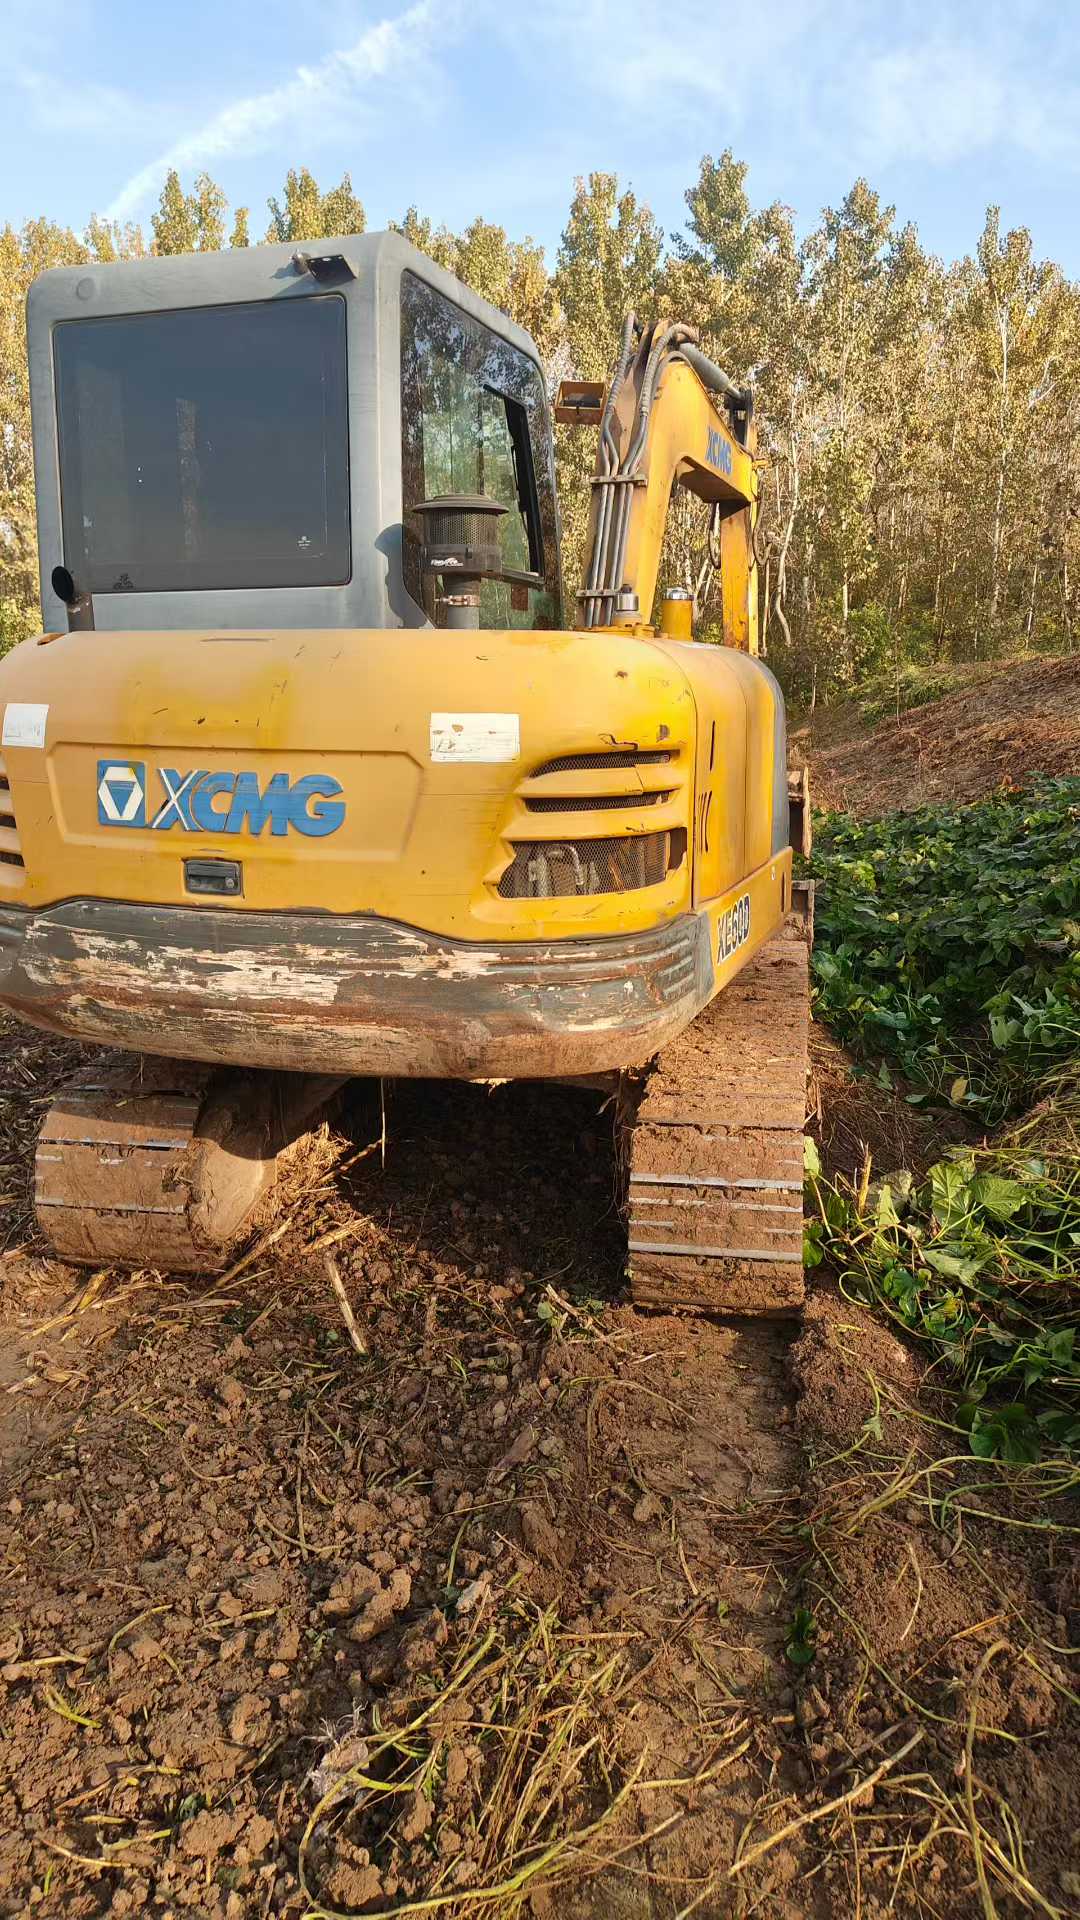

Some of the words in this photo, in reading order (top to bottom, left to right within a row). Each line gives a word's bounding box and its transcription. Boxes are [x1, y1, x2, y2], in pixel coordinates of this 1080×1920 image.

[706, 427, 732, 475] XCMG
[151, 768, 346, 837] XCMG
[717, 894, 750, 965] XE60D
